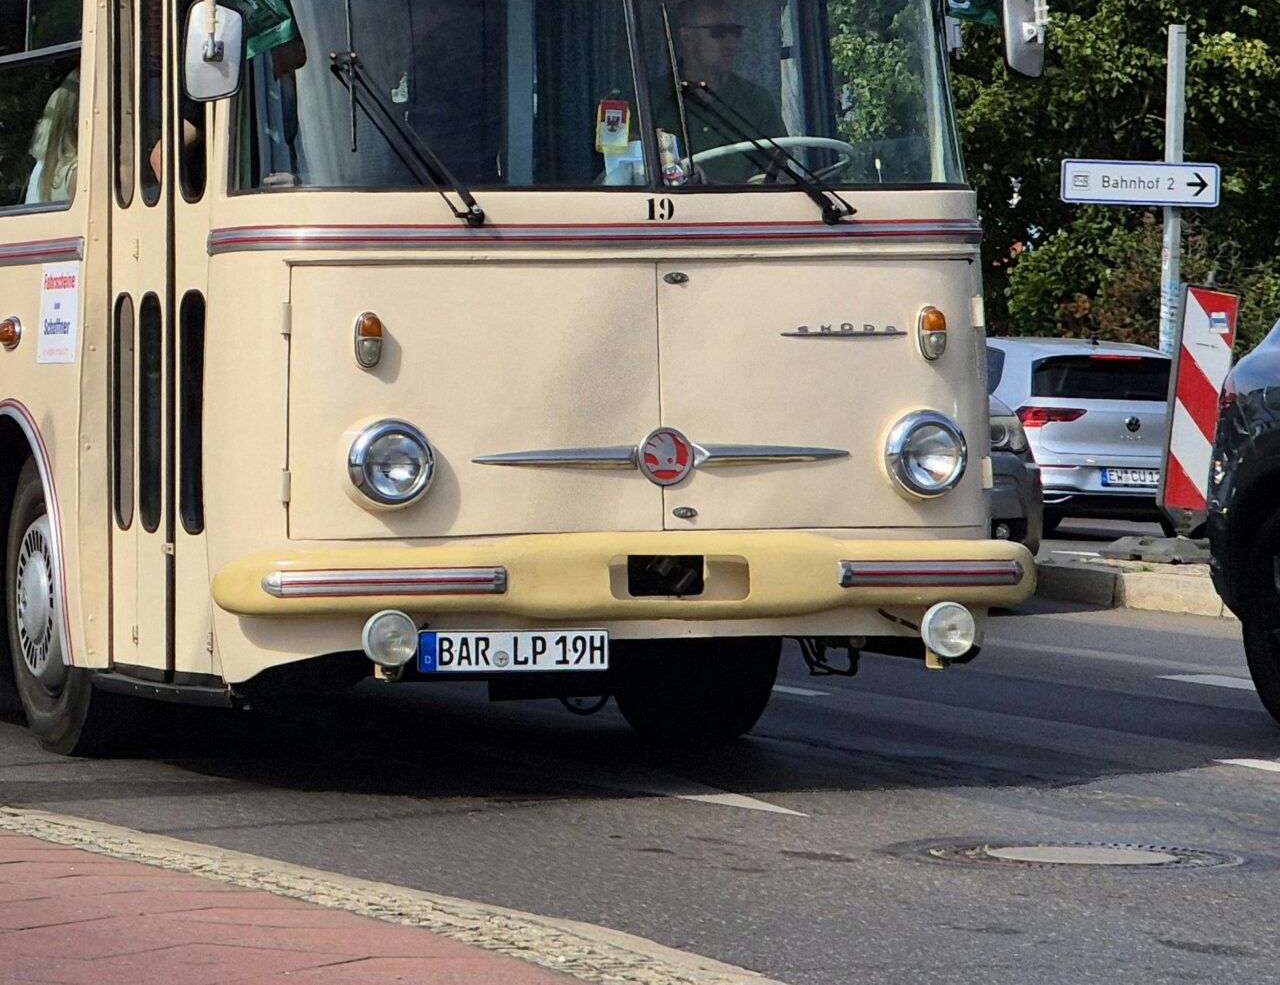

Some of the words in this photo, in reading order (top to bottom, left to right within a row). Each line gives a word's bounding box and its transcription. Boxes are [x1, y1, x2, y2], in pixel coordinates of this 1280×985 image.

[1101, 175, 1160, 190] Bahnhof
[1167, 177, 1175, 190] 2
[646, 197, 675, 221] 19
[44, 273, 76, 290] Fahrscheine
[43, 318, 71, 336] Schaffner
[1108, 469, 1123, 481] EW
[1131, 470, 1146, 483] CU
[438, 637, 490, 666] BAR
[513, 636, 547, 665] LP
[555, 635, 605, 664] 19H
